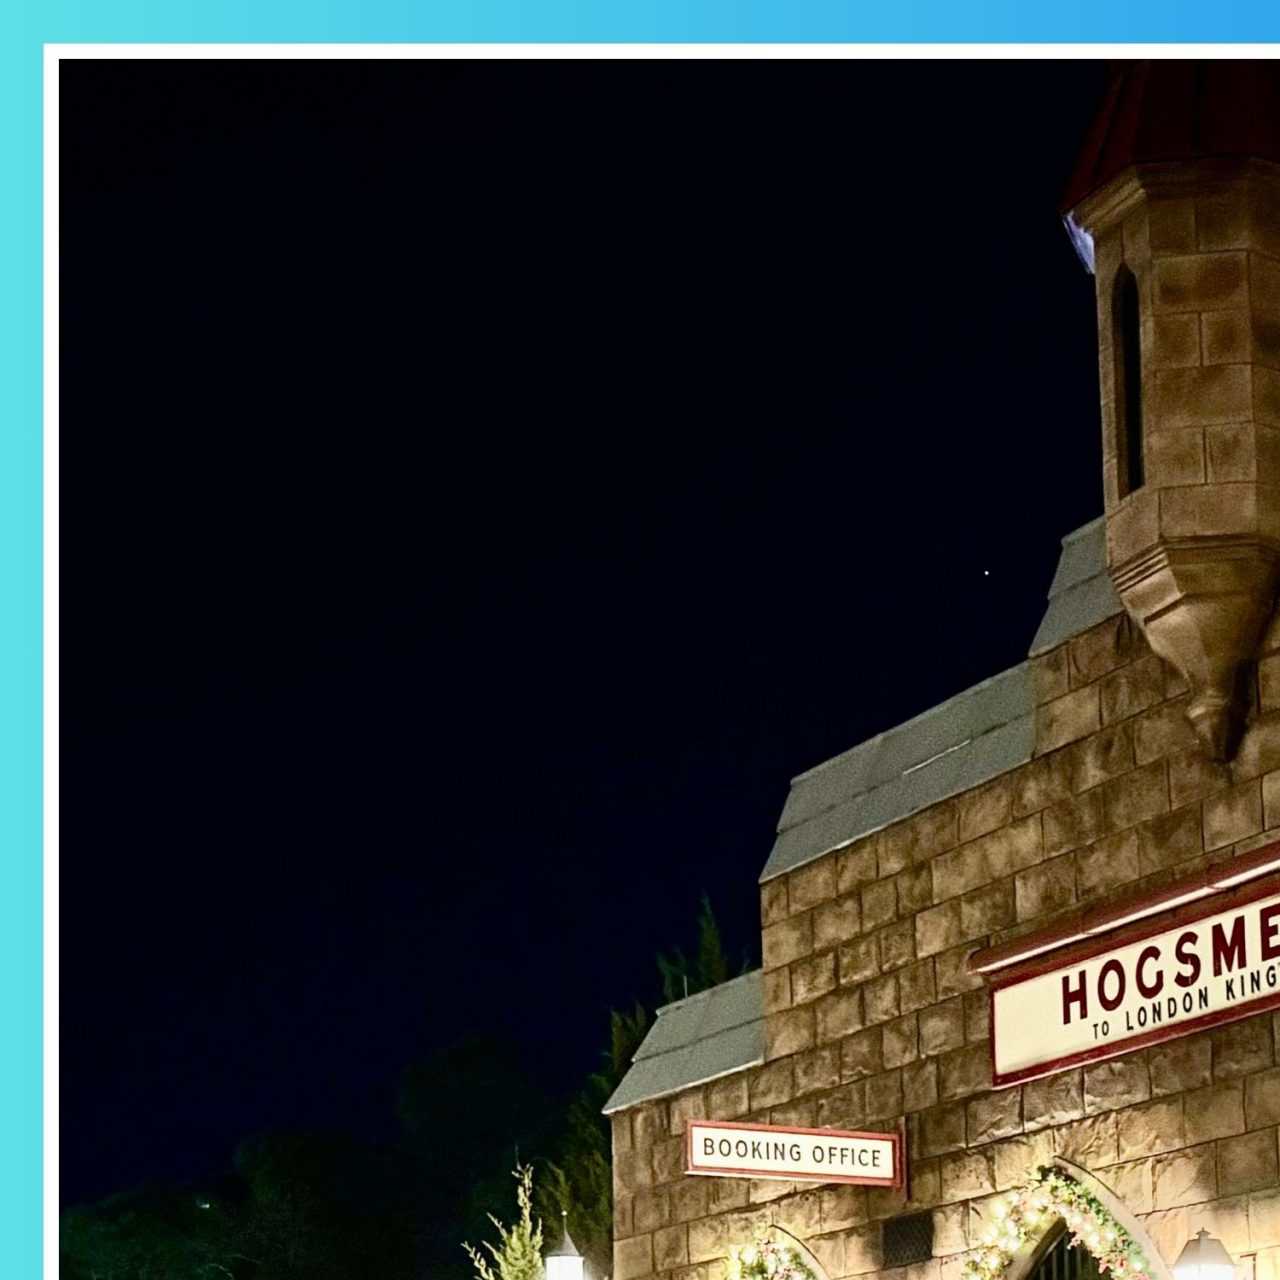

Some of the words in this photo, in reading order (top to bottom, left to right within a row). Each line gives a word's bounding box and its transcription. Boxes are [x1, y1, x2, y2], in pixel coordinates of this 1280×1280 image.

[1093, 1020, 1110, 1040] TO
[1126, 986, 1209, 1031] LONDON
[703, 1136, 802, 1162] BOOKING
[812, 1144, 881, 1168] OFFICE
